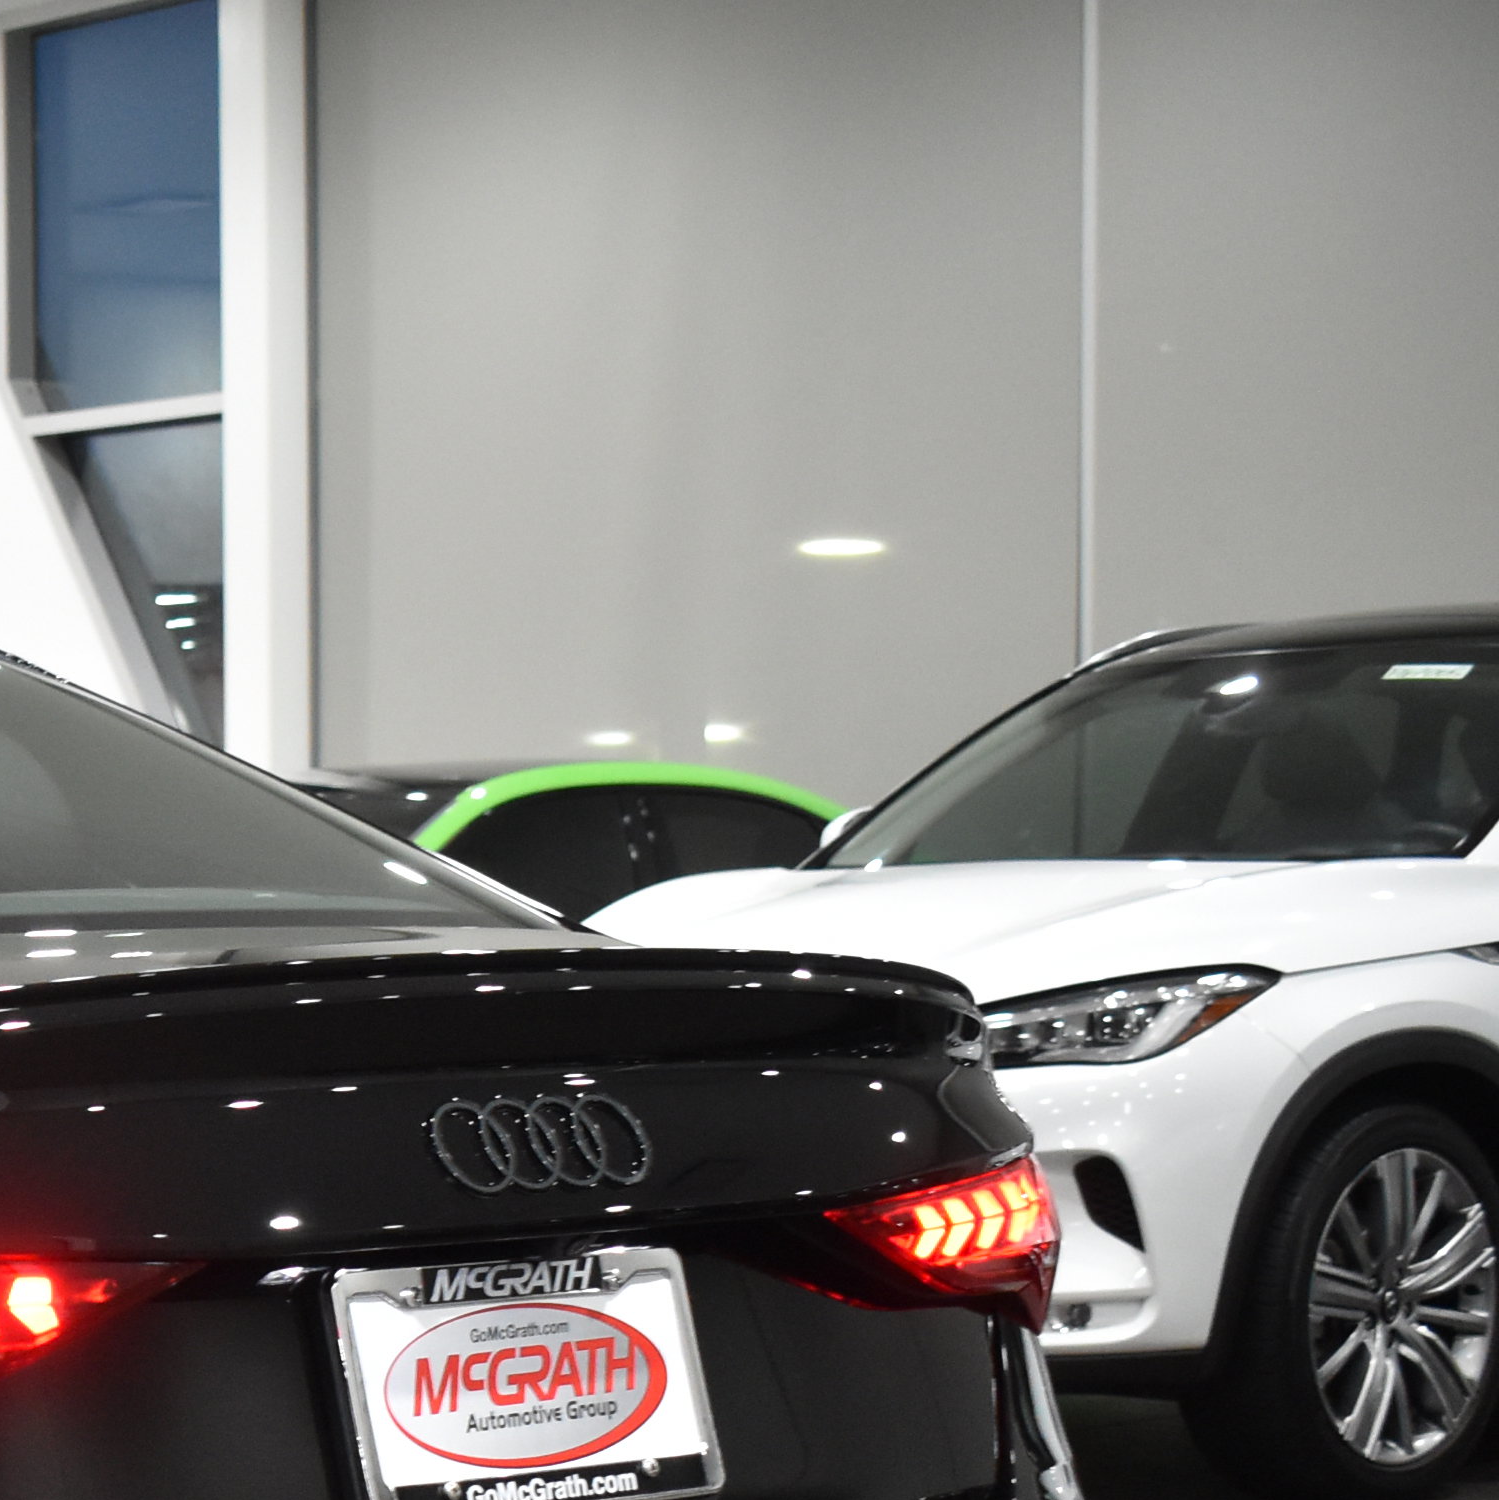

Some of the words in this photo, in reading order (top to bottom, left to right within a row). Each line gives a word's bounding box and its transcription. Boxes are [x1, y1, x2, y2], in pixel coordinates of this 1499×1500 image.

[469, 1321, 570, 1343] GoMcGrath.com
[466, 1405, 561, 1434] Automotive
[566, 1399, 619, 1421] Group
